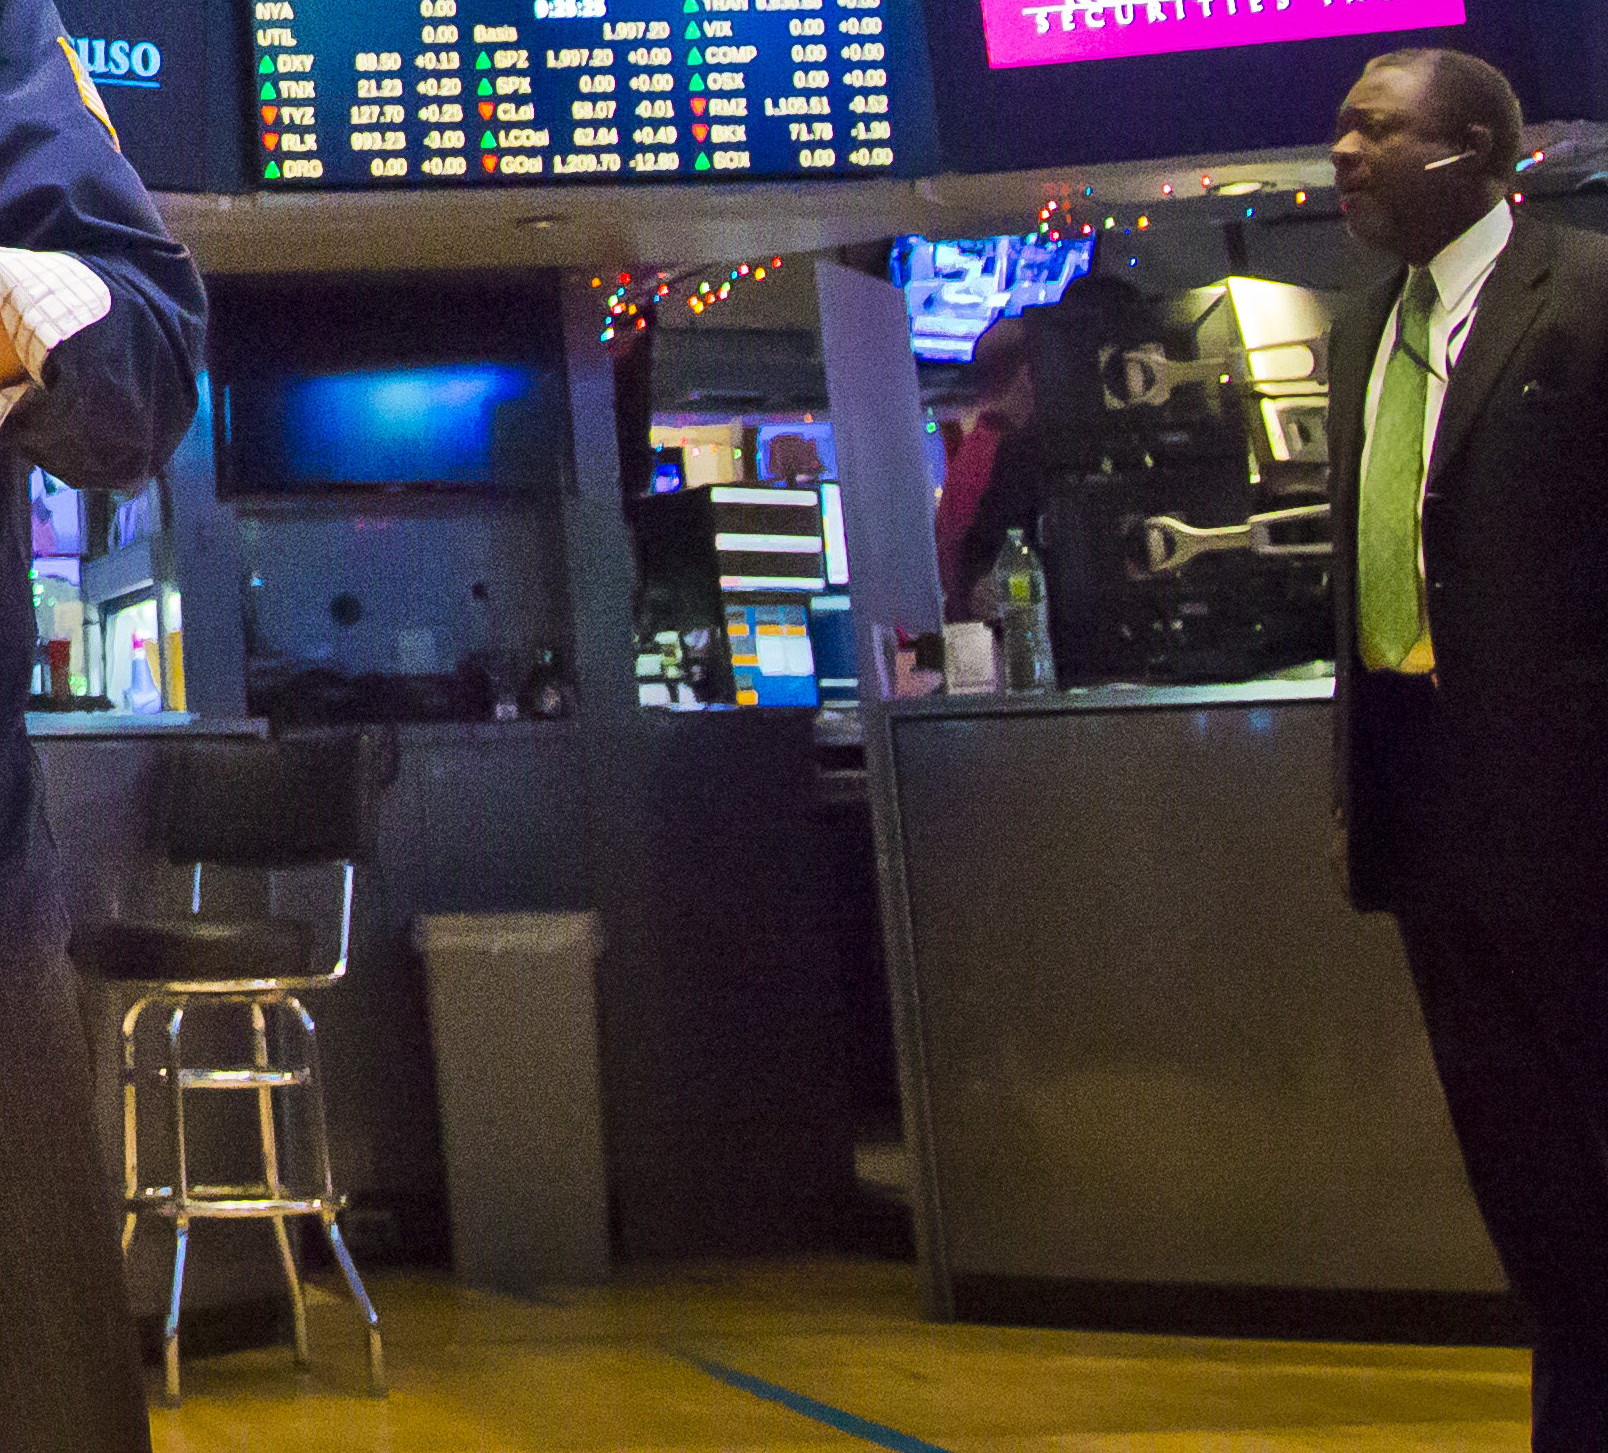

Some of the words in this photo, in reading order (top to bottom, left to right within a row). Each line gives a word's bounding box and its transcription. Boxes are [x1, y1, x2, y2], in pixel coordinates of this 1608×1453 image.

[255, 1, 294, 20] NYA
[257, 28, 297, 47] UTIL
[421, 24, 459, 43] 0.00
[703, 19, 733, 38] VIX
[789, 18, 825, 37] 0.00
[70, 36, 162, 79] uso
[277, 53, 315, 73] DXY
[494, 49, 530, 69] SPZ
[705, 45, 757, 64] COMP
[791, 44, 828, 63] 0.00
[278, 80, 315, 99] TNX
[496, 76, 531, 95] SPX
[579, 73, 616, 93] 0.00
[707, 72, 745, 90] OSX
[793, 70, 829, 89] 0.00
[281, 106, 315, 125] TYZ
[370, 157, 408, 177] 0.00
[799, 148, 836, 168] 0.00
